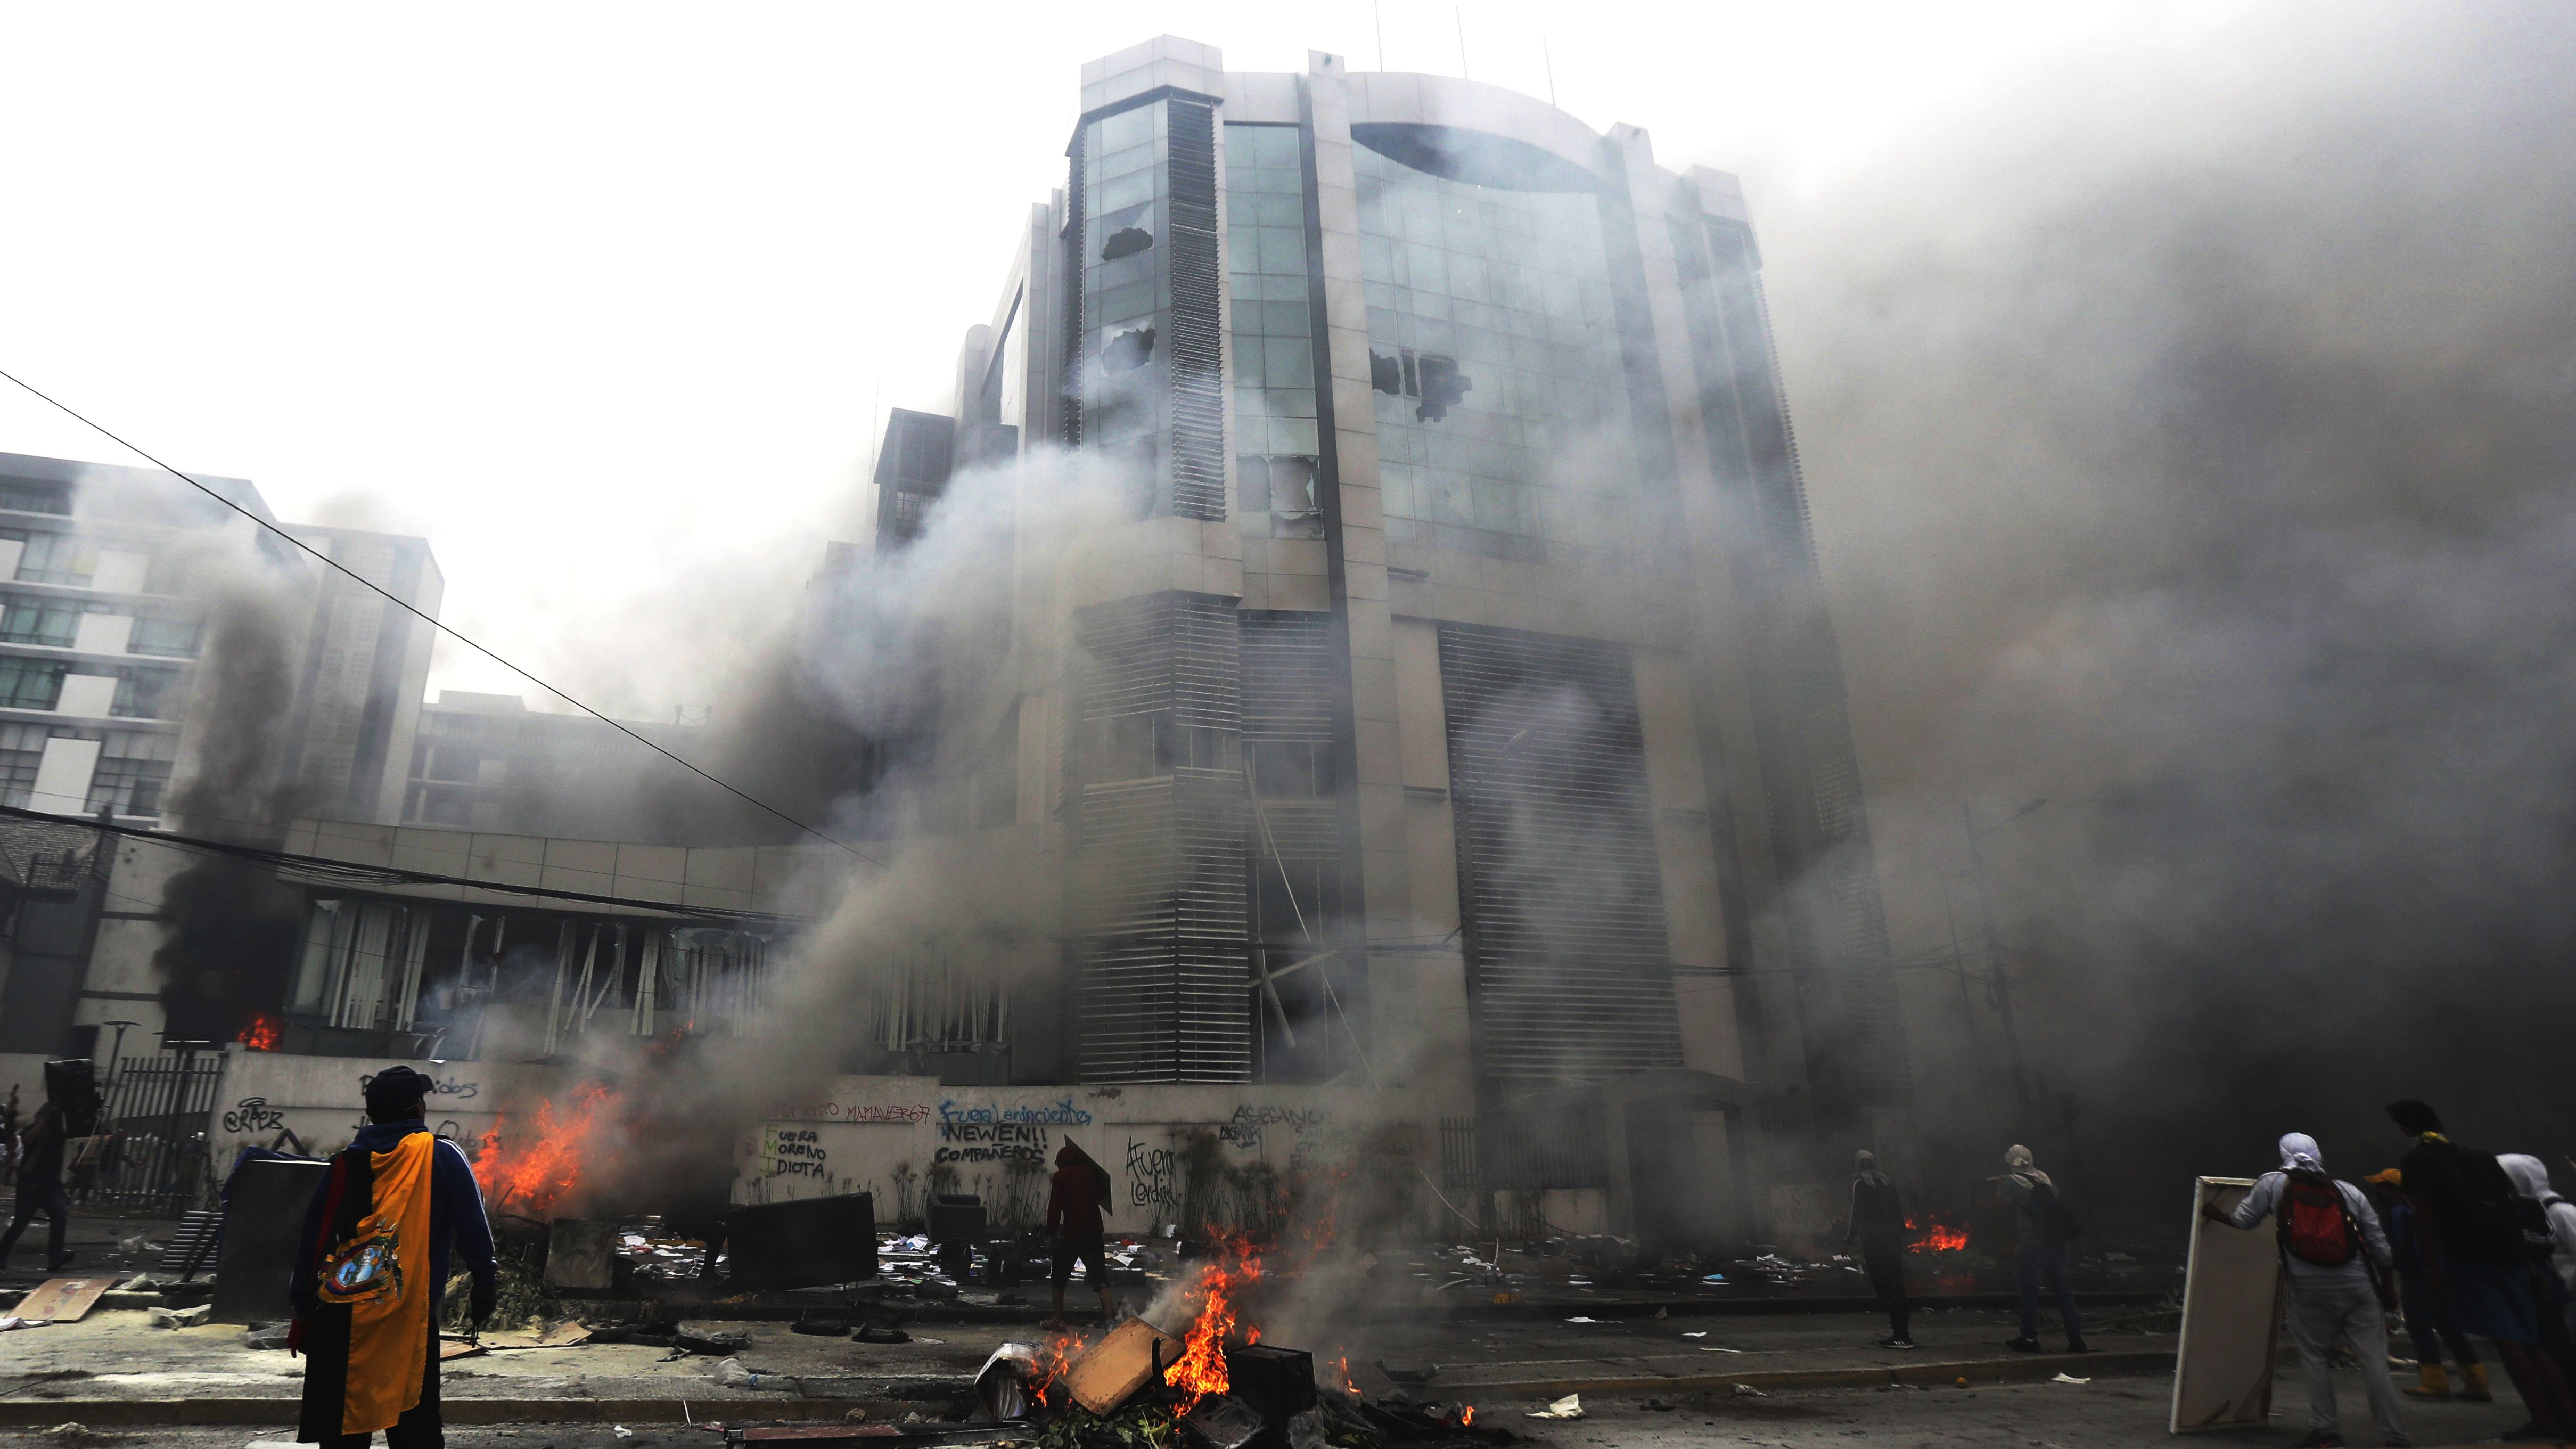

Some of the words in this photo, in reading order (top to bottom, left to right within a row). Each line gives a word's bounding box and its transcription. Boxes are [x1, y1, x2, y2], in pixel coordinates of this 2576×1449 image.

[765, 1124, 818, 1143] FUERA
[763, 1140, 826, 1160] MORENO
[760, 1156, 825, 1178] IDIOTA
